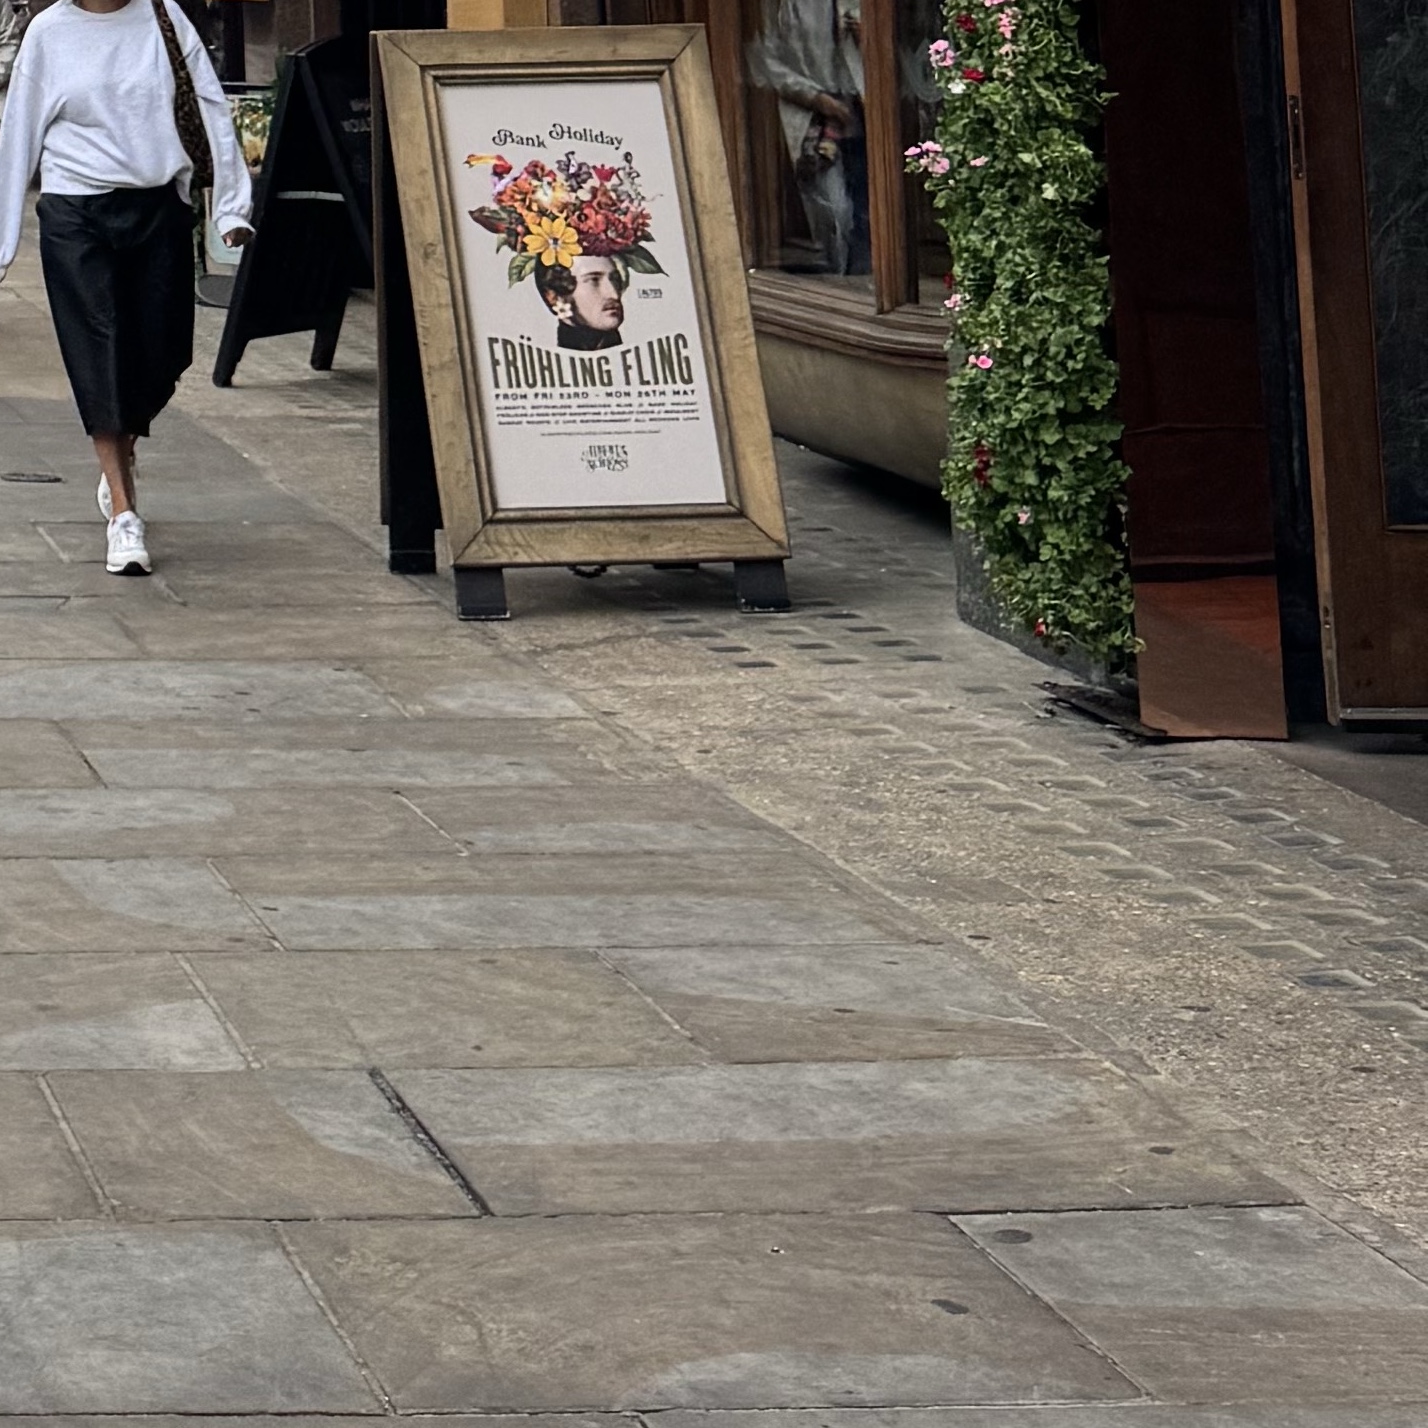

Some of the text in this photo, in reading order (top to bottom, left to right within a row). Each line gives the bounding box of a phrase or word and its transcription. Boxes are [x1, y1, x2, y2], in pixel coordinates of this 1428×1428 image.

[492, 123, 624, 150] Bank Holiday
[487, 333, 694, 390] FRÜHLING FLING
[495, 392, 528, 401] FROM
[533, 392, 553, 400] FRI
[605, 390, 632, 399] MON
